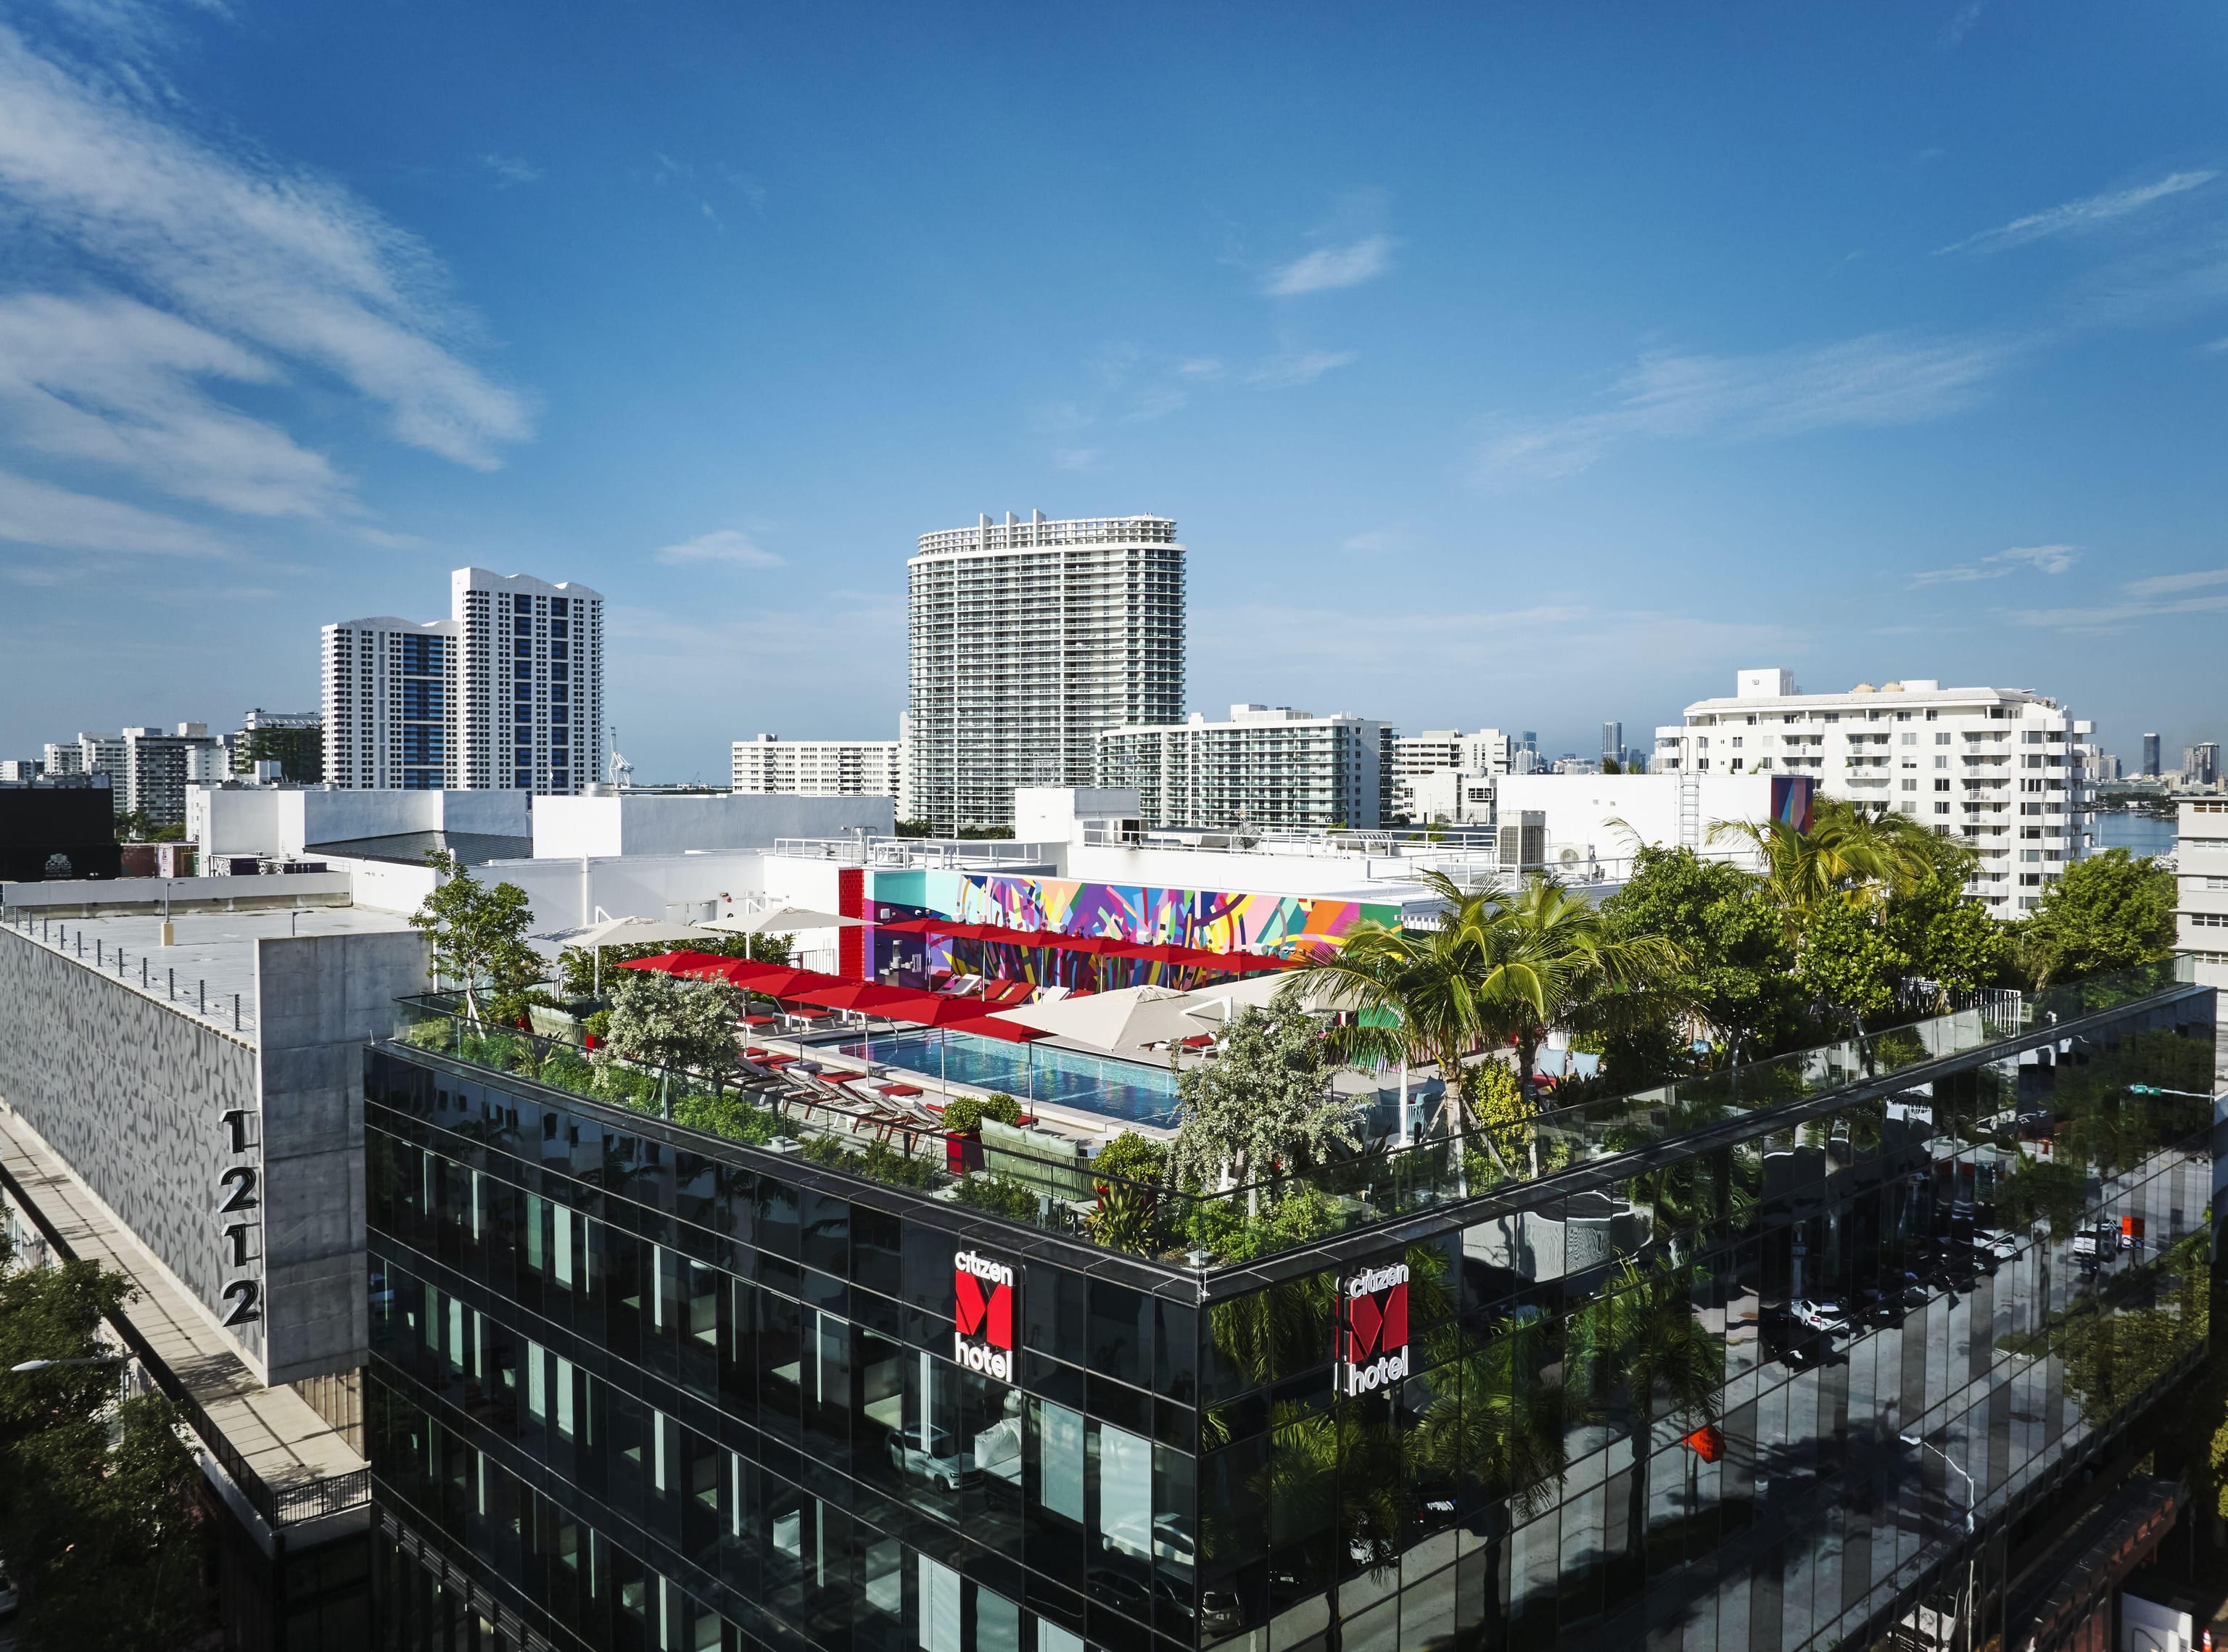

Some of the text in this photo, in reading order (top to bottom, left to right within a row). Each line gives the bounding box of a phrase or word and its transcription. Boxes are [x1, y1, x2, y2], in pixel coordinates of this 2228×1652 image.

[217, 1108, 259, 1327] 1212
[954, 1250, 1013, 1287] citizen
[1349, 1264, 1409, 1298] citizen
[954, 1331, 1013, 1382] hotel
[1349, 1345, 1408, 1397] hotel
